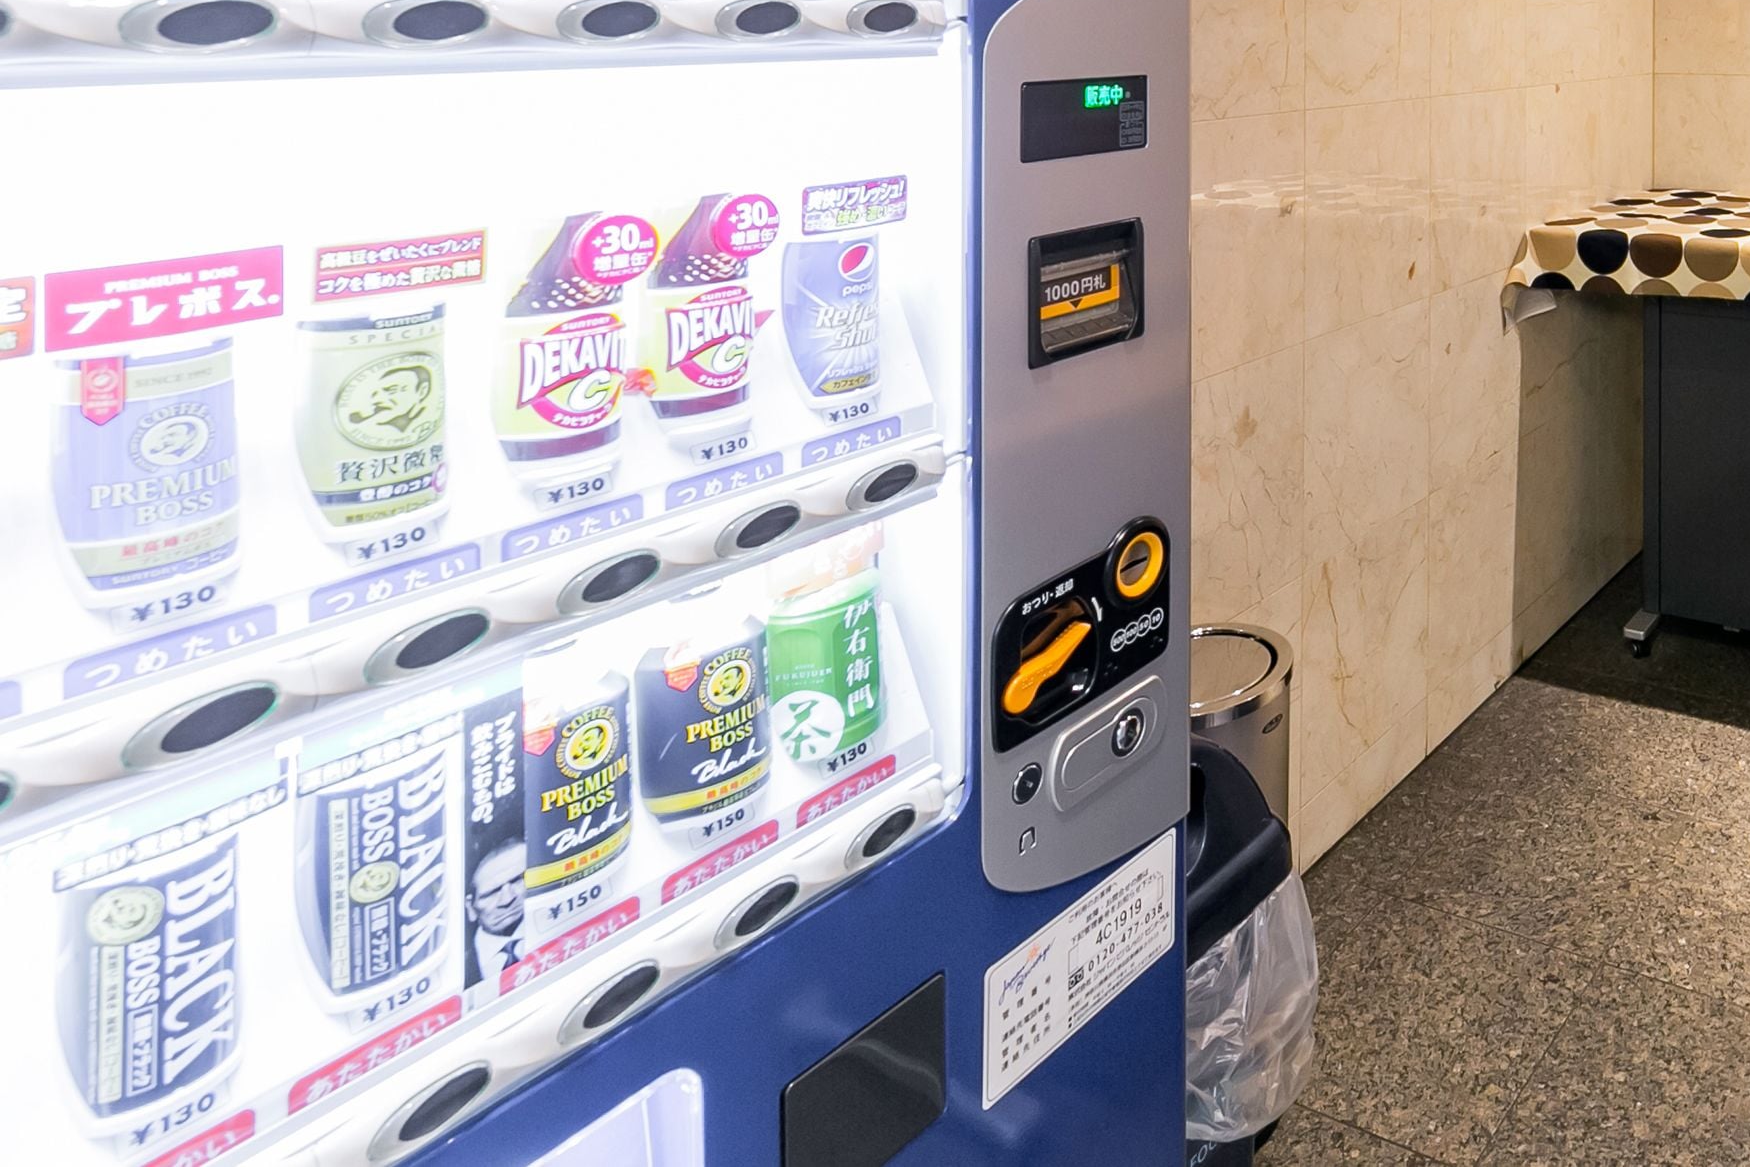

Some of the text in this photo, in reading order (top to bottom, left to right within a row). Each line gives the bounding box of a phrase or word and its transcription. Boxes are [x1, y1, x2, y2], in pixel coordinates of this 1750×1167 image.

[701, 288, 743, 302] SUNTORY
[1044, 274, 1106, 302] 1000円札
[349, 324, 442, 345] SPECIA
[562, 316, 611, 331] SUNTORY
[712, 335, 747, 373] C
[568, 368, 611, 411] C
[829, 402, 869, 422] ¥130
[701, 435, 749, 460] ¥130
[812, 424, 893, 463] つめたい
[548, 476, 605, 504] ¥130
[677, 463, 773, 504] つめたい
[136, 490, 215, 527] BOSS
[357, 526, 426, 561] ¥130
[516, 506, 632, 554] つめたい
[131, 585, 217, 622] ¥130
[325, 558, 465, 612] つめたい
[1021, 578, 1074, 615] おつり・返却
[84, 621, 259, 687] つめたい
[704, 646, 752, 675] COFFEE
[844, 599, 875, 718] 伊右衛門
[562, 705, 615, 738] COFFEE
[686, 695, 767, 744] PREMIUM
[711, 721, 754, 753] BOSS
[780, 699, 832, 761] 茶
[692, 737, 766, 784] Black
[827, 741, 867, 773] ¥130
[541, 754, 629, 812] PREMIUM
[568, 785, 615, 822] BOSS
[702, 807, 745, 838] ¥150
[362, 786, 395, 863] BOSS
[547, 801, 629, 856] Black
[399, 748, 450, 967] BLACK
[549, 883, 602, 921] ¥150
[1096, 898, 1142, 945] 4C1919
[1088, 901, 1163, 972] 0120-477-038
[127, 934, 162, 1010] BOSS
[163, 847, 235, 1085] BLACK
[362, 976, 431, 1022] ¥130
[131, 1091, 215, 1145] ¥130
